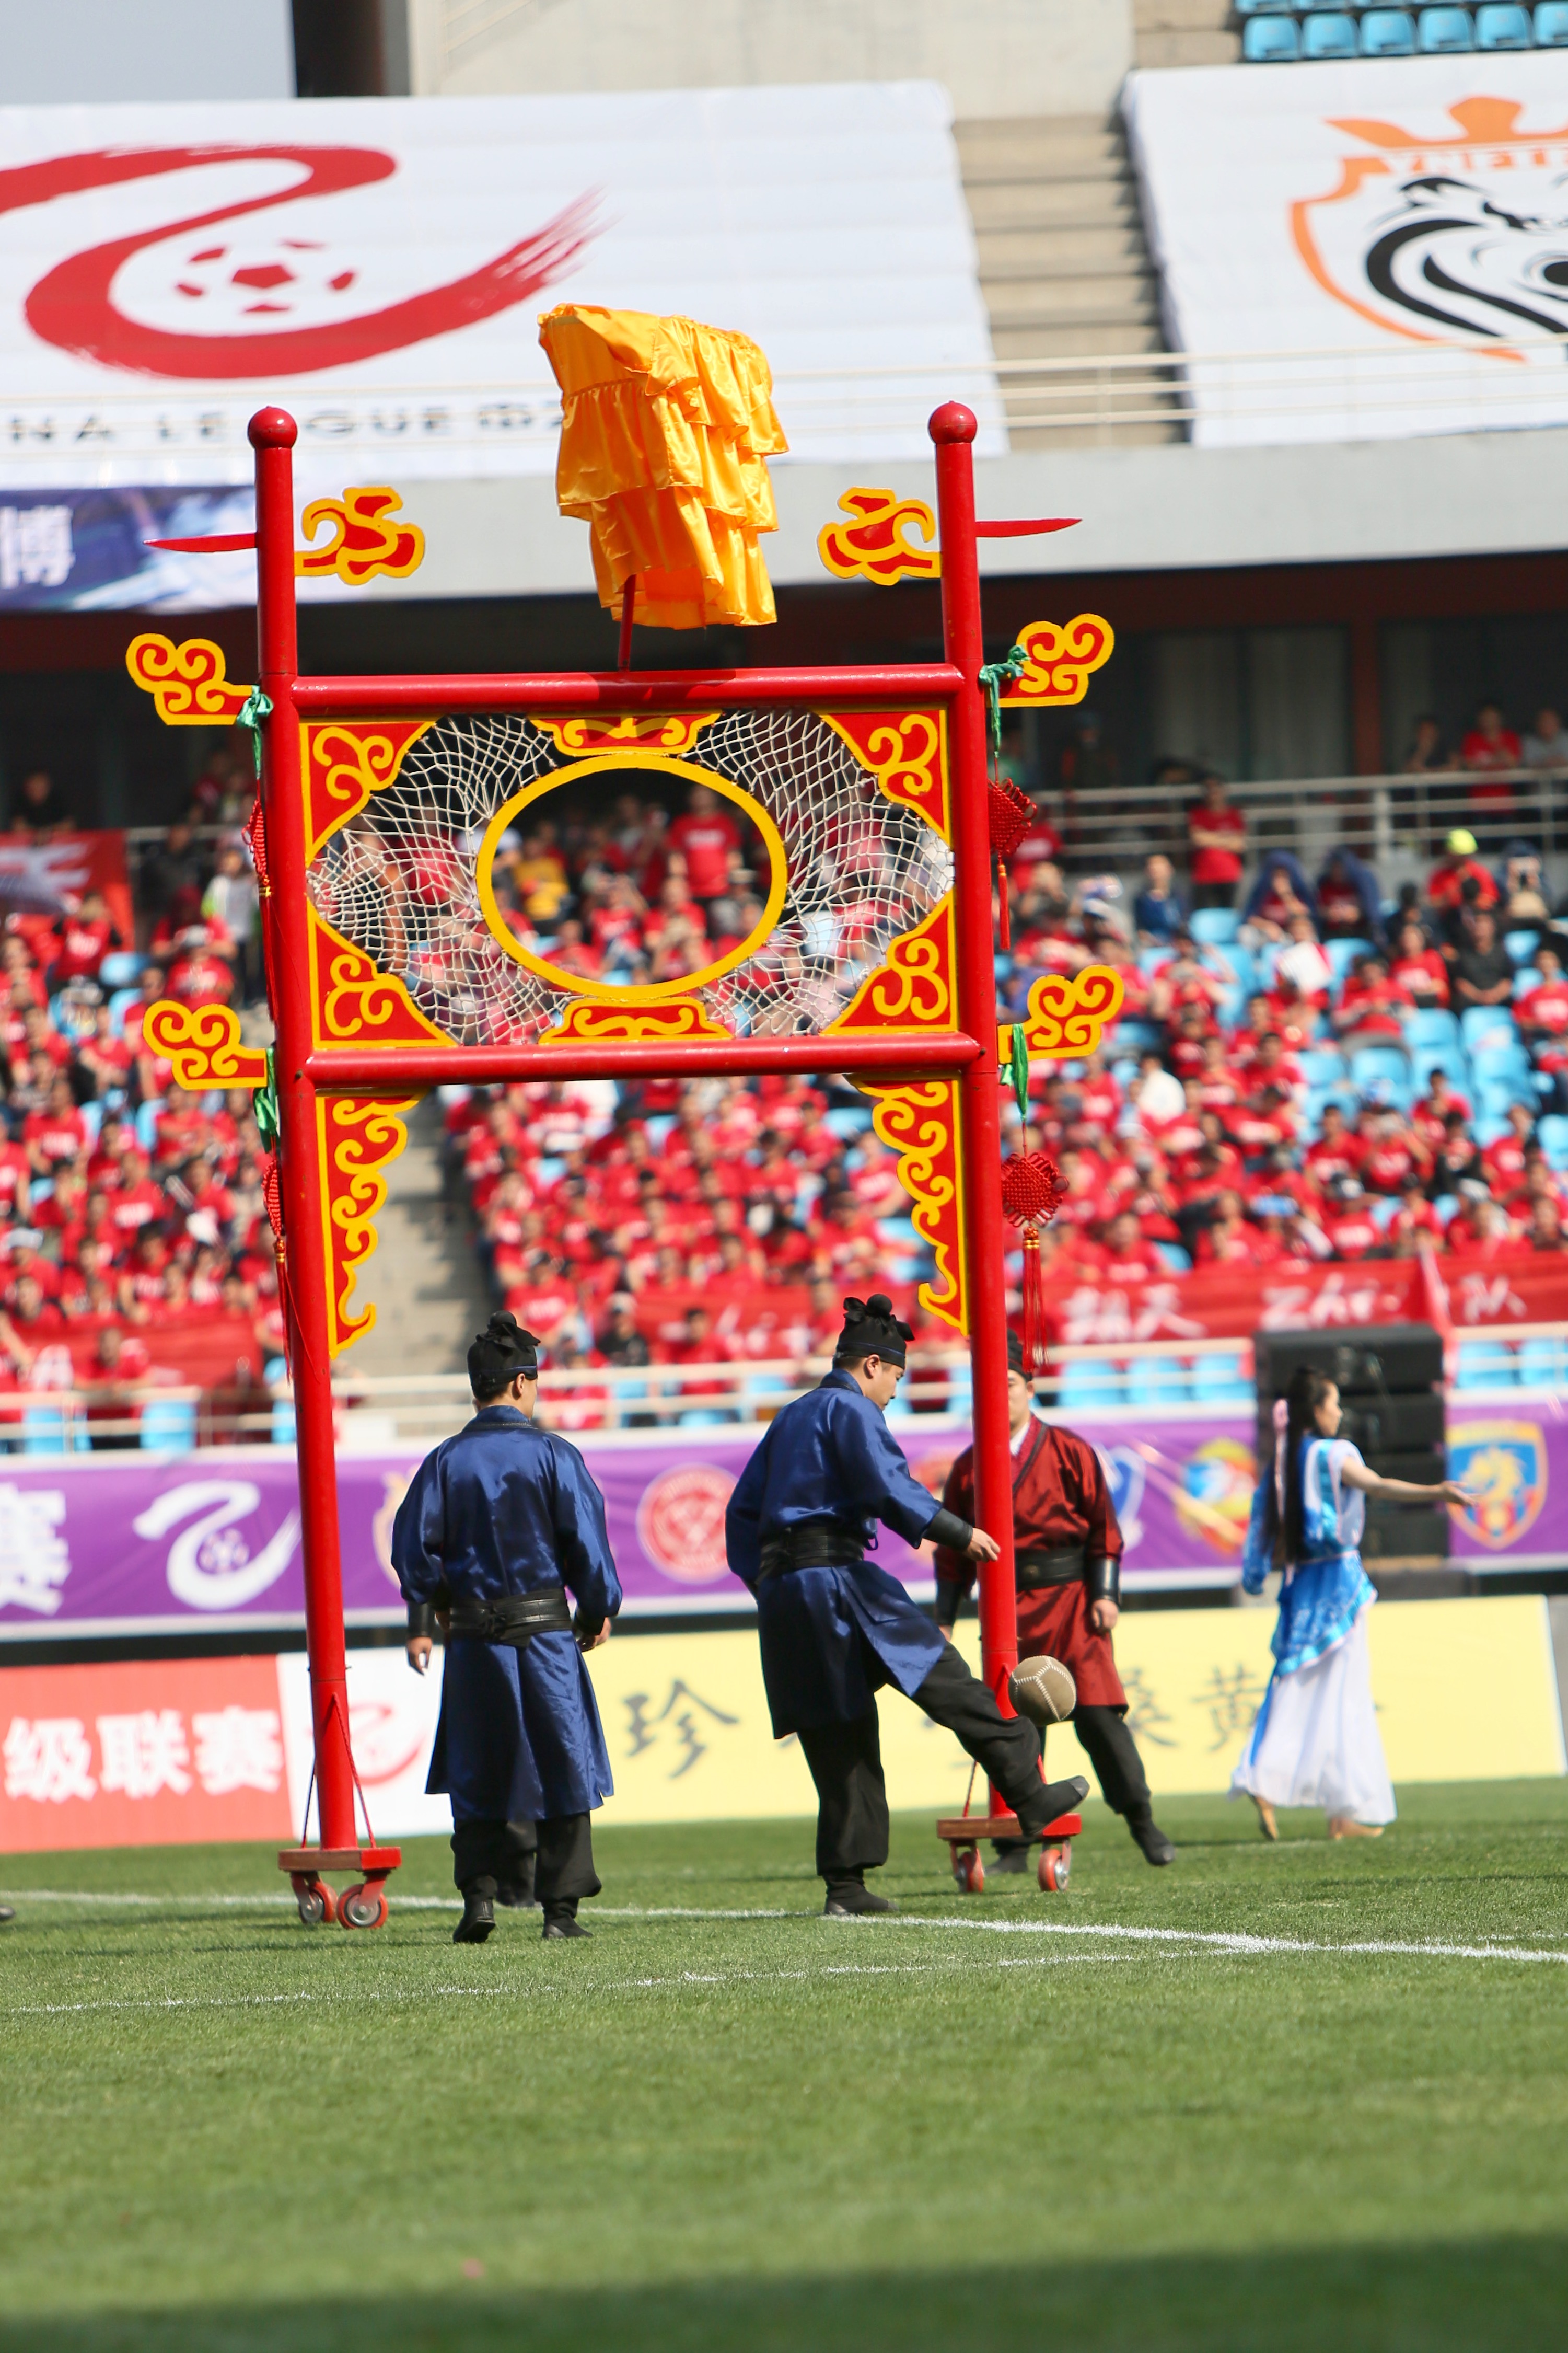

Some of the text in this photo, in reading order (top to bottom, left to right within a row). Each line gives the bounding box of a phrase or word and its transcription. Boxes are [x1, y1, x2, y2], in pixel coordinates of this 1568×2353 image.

[158, 408, 449, 443] LEGUE
[2, 1705, 285, 1804] 级联赛
